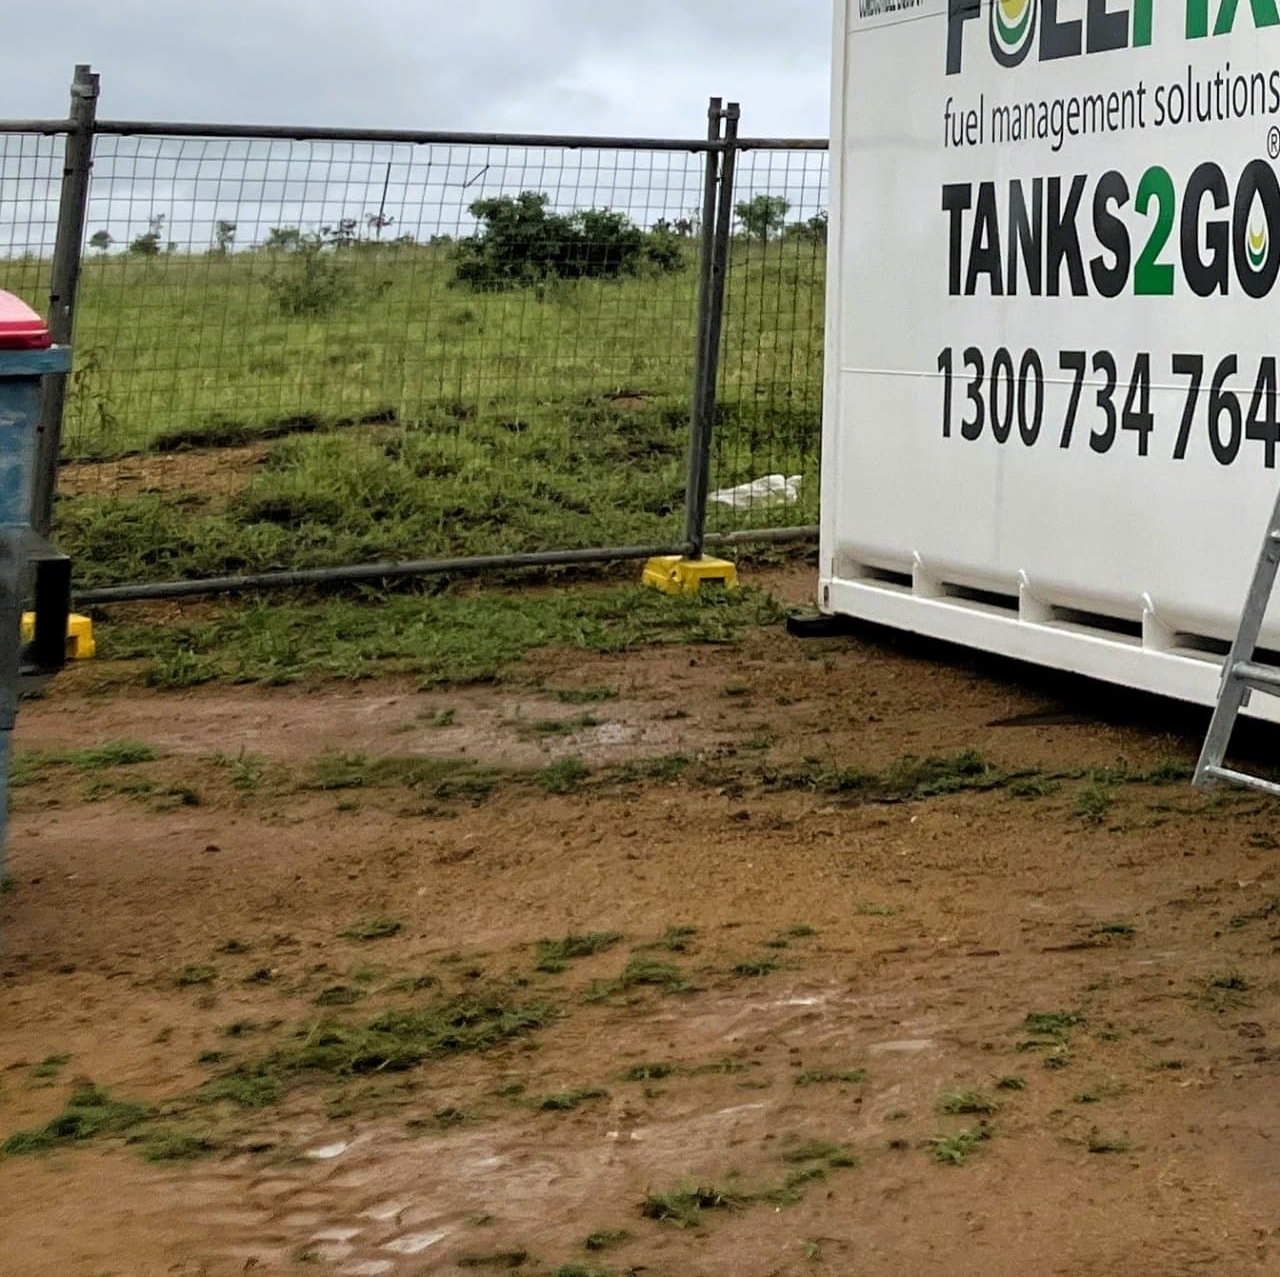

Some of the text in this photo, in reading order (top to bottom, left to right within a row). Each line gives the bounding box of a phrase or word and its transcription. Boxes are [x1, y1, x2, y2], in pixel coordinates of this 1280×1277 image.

[944, 62, 1280, 152] fuel management solutions
[937, 346, 1044, 447] 1300
[1059, 349, 1154, 456] 734
